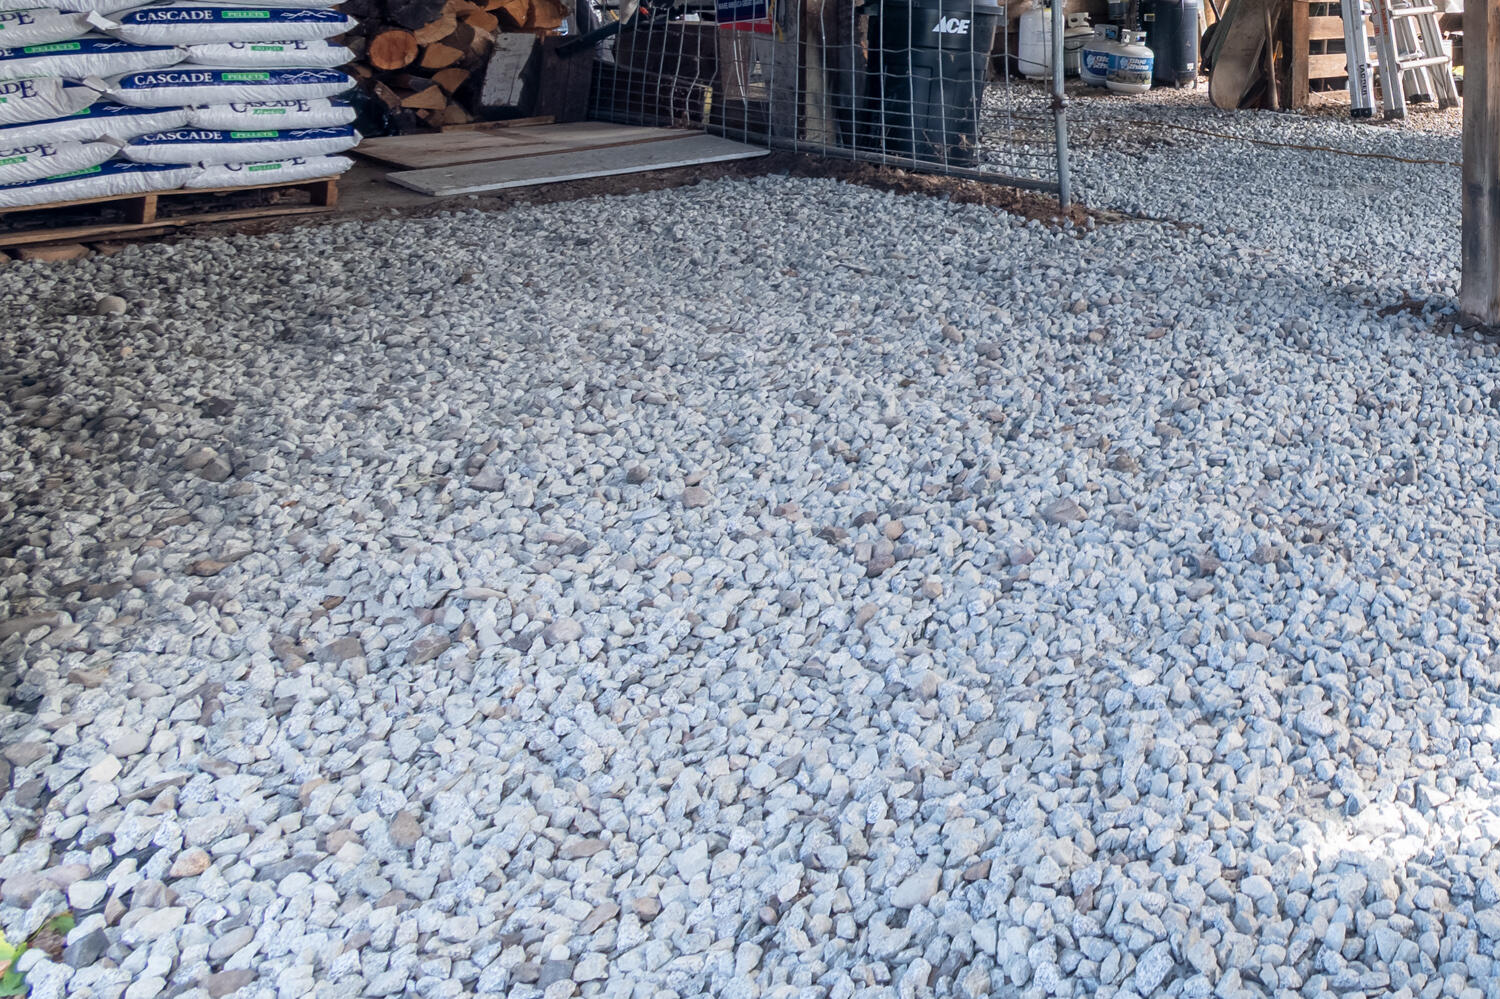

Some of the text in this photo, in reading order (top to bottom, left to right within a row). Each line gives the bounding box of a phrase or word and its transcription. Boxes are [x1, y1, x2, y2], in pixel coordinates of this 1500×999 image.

[135, 10, 214, 22] CASCADE
[932, 15, 971, 35] ACE
[31, 43, 74, 53] PELLETS
[133, 72, 213, 86] CASCADE
[143, 130, 223, 141] CASCADE
